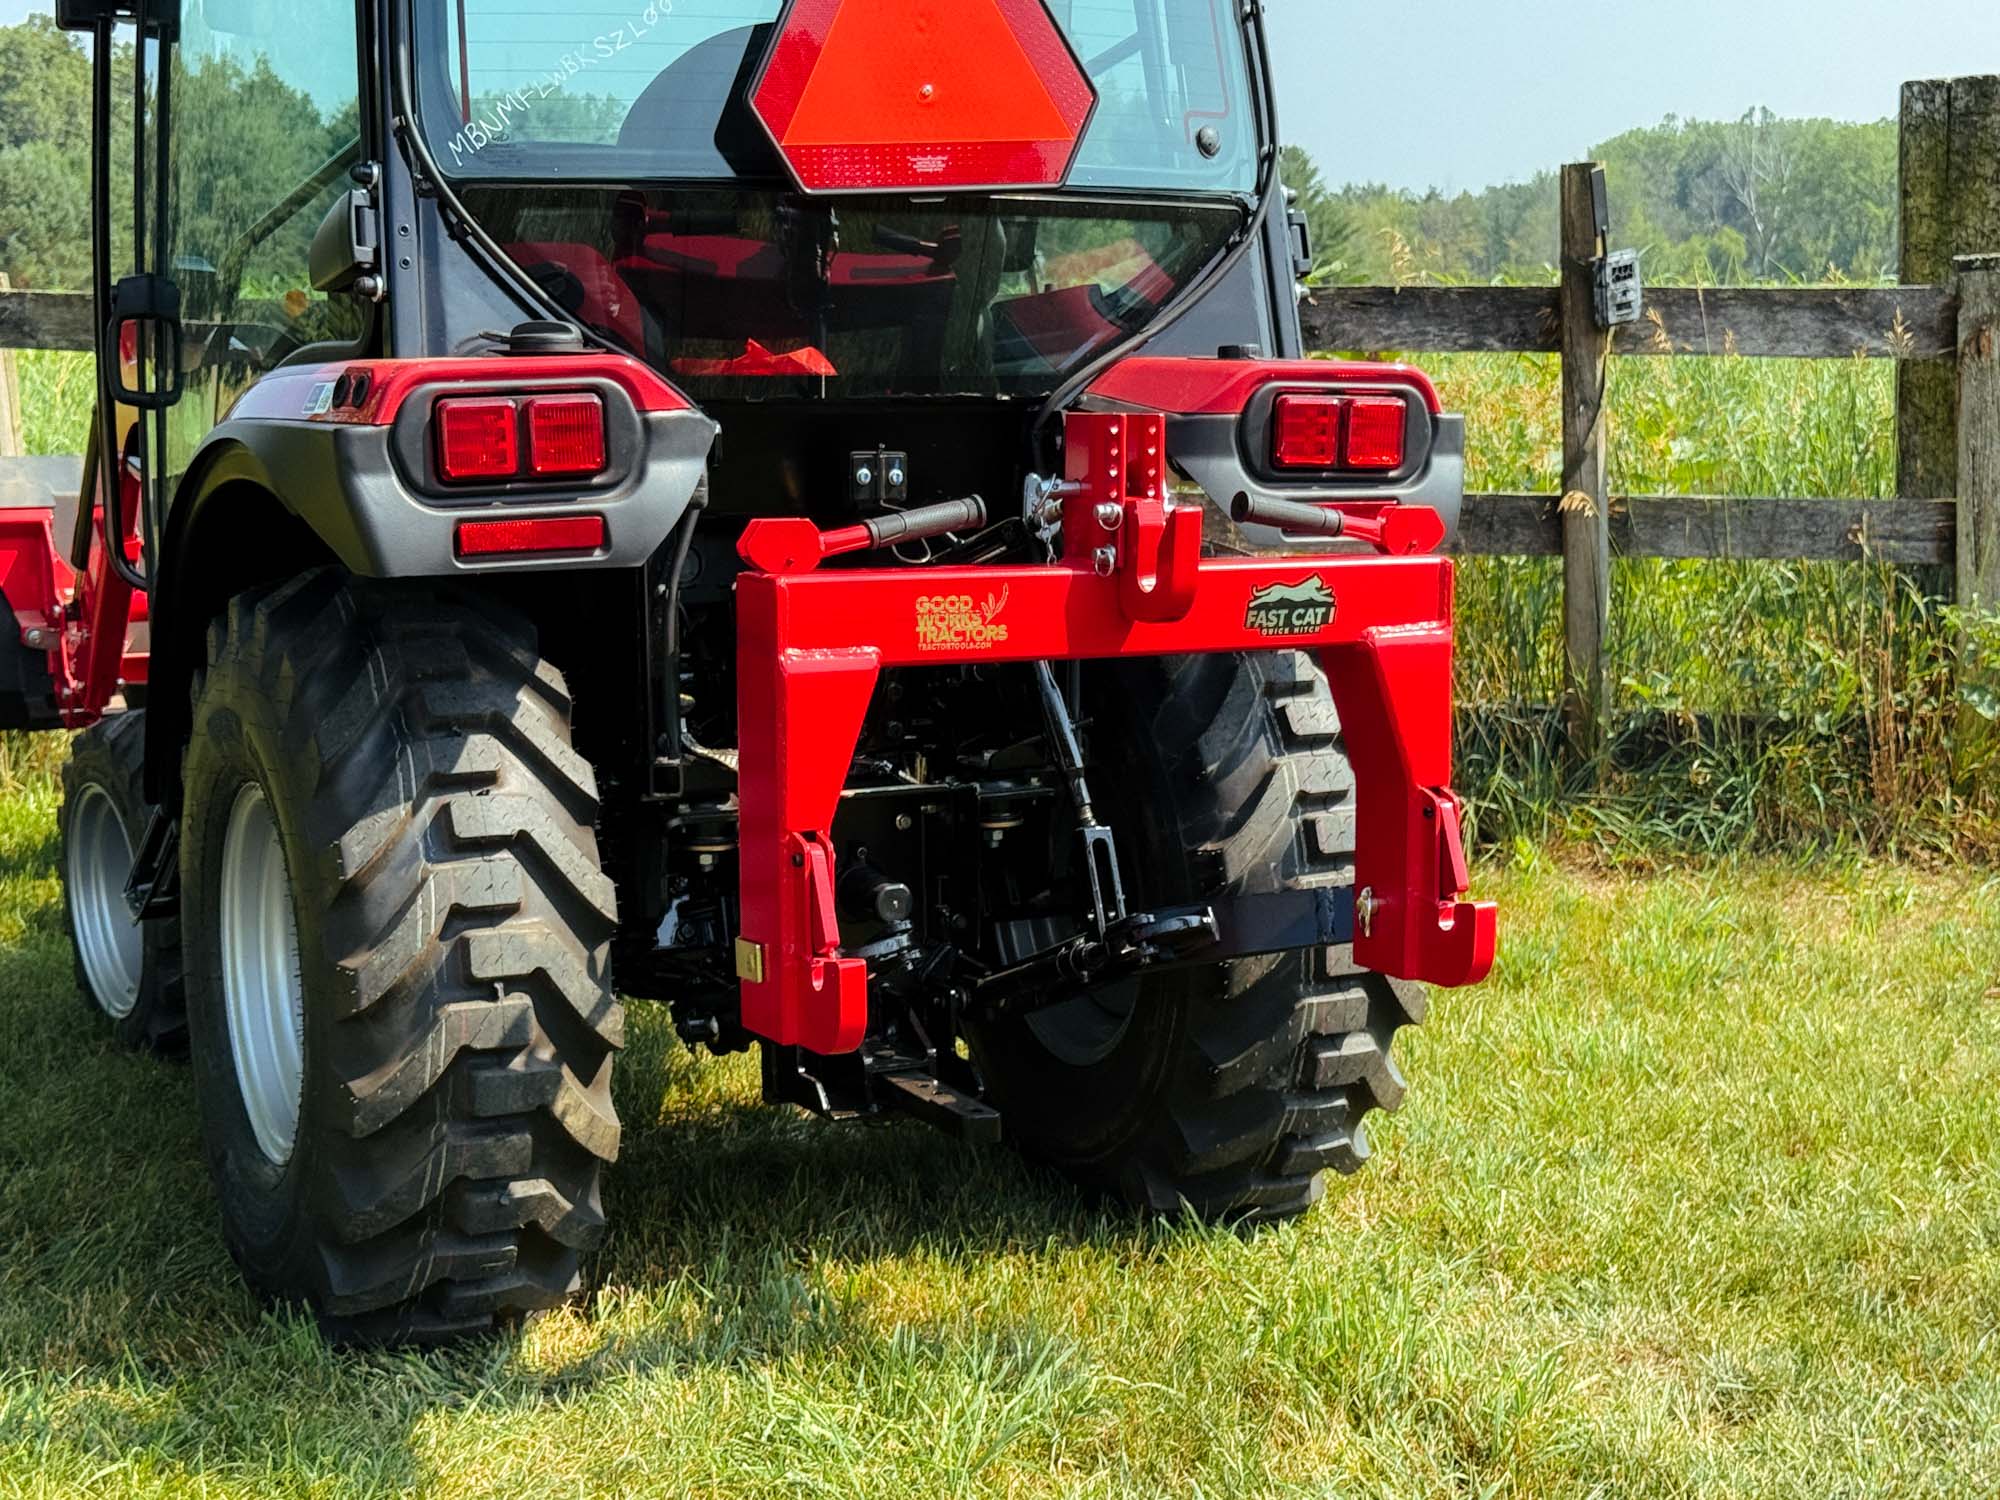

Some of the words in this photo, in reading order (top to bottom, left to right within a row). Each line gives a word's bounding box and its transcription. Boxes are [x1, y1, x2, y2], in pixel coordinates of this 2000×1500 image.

[916, 595, 973, 612] GOOD
[917, 611, 983, 627] WORKS
[1247, 609, 1289, 627] FAST
[1291, 607, 1326, 626] CAT
[916, 625, 1008, 642] TRACTORS
[1261, 627, 1290, 636] QUICK
[1293, 625, 1321, 634] HITCH
